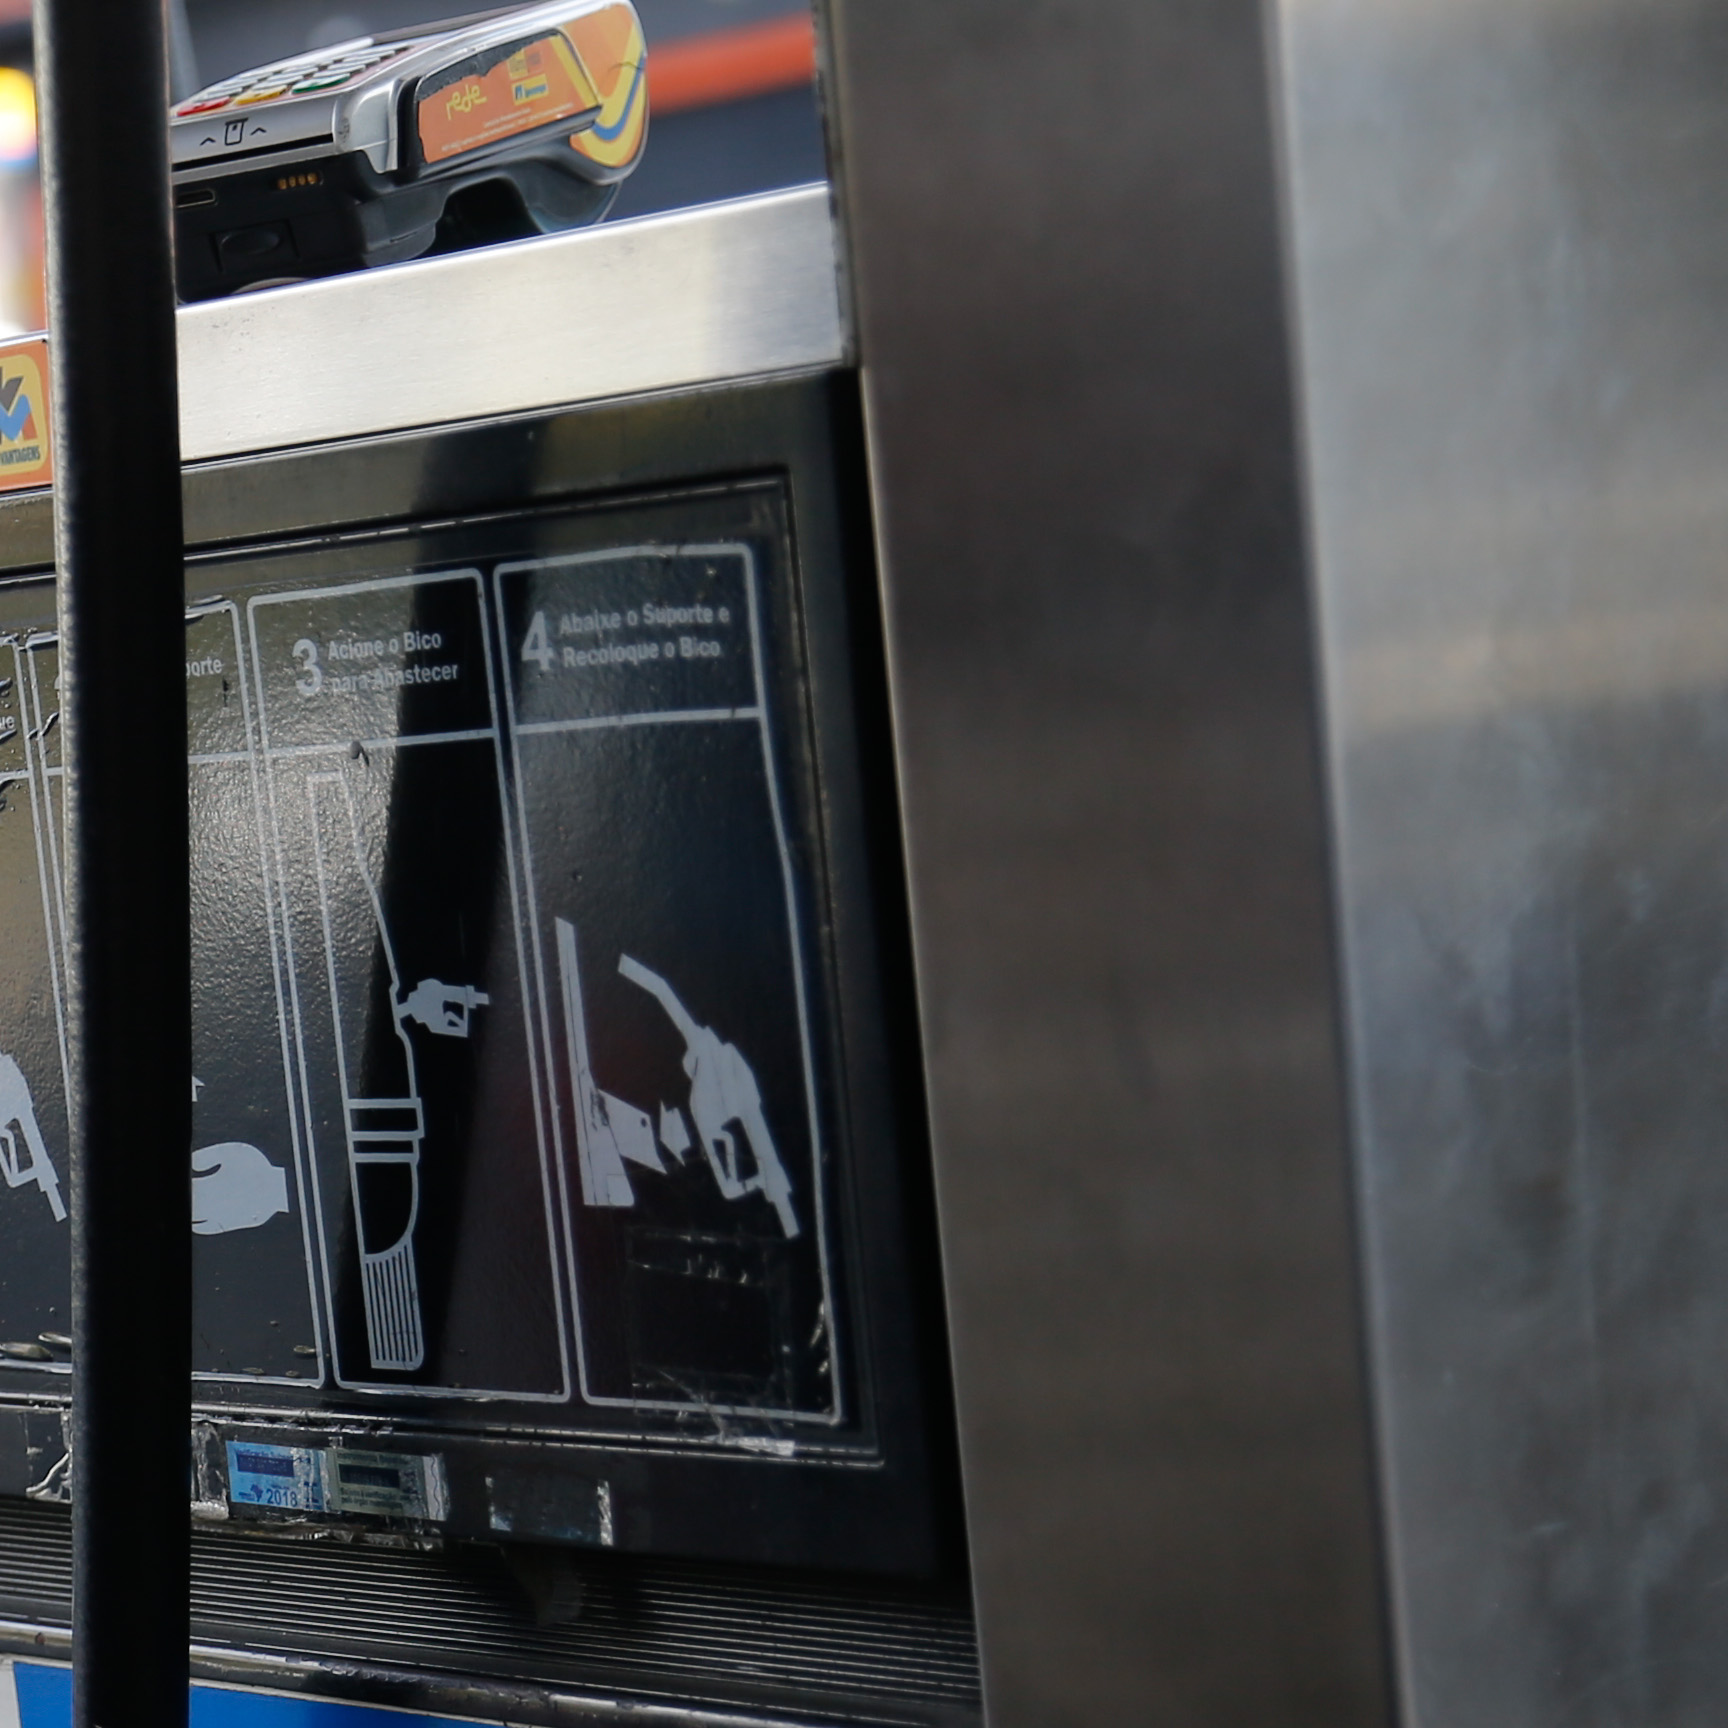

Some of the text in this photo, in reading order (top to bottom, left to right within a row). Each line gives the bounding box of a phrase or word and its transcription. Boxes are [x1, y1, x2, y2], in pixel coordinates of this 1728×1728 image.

[446, 83, 487, 121] rede
[560, 602, 730, 636] Abaixe o Suporte e
[328, 630, 442, 660] Acione o Bico
[521, 610, 555, 672] 4
[562, 636, 721, 667] Recoloque o Bico
[294, 638, 322, 694] 3
[374, 663, 458, 688] Abastecer
[265, 1487, 298, 1507] 2018
